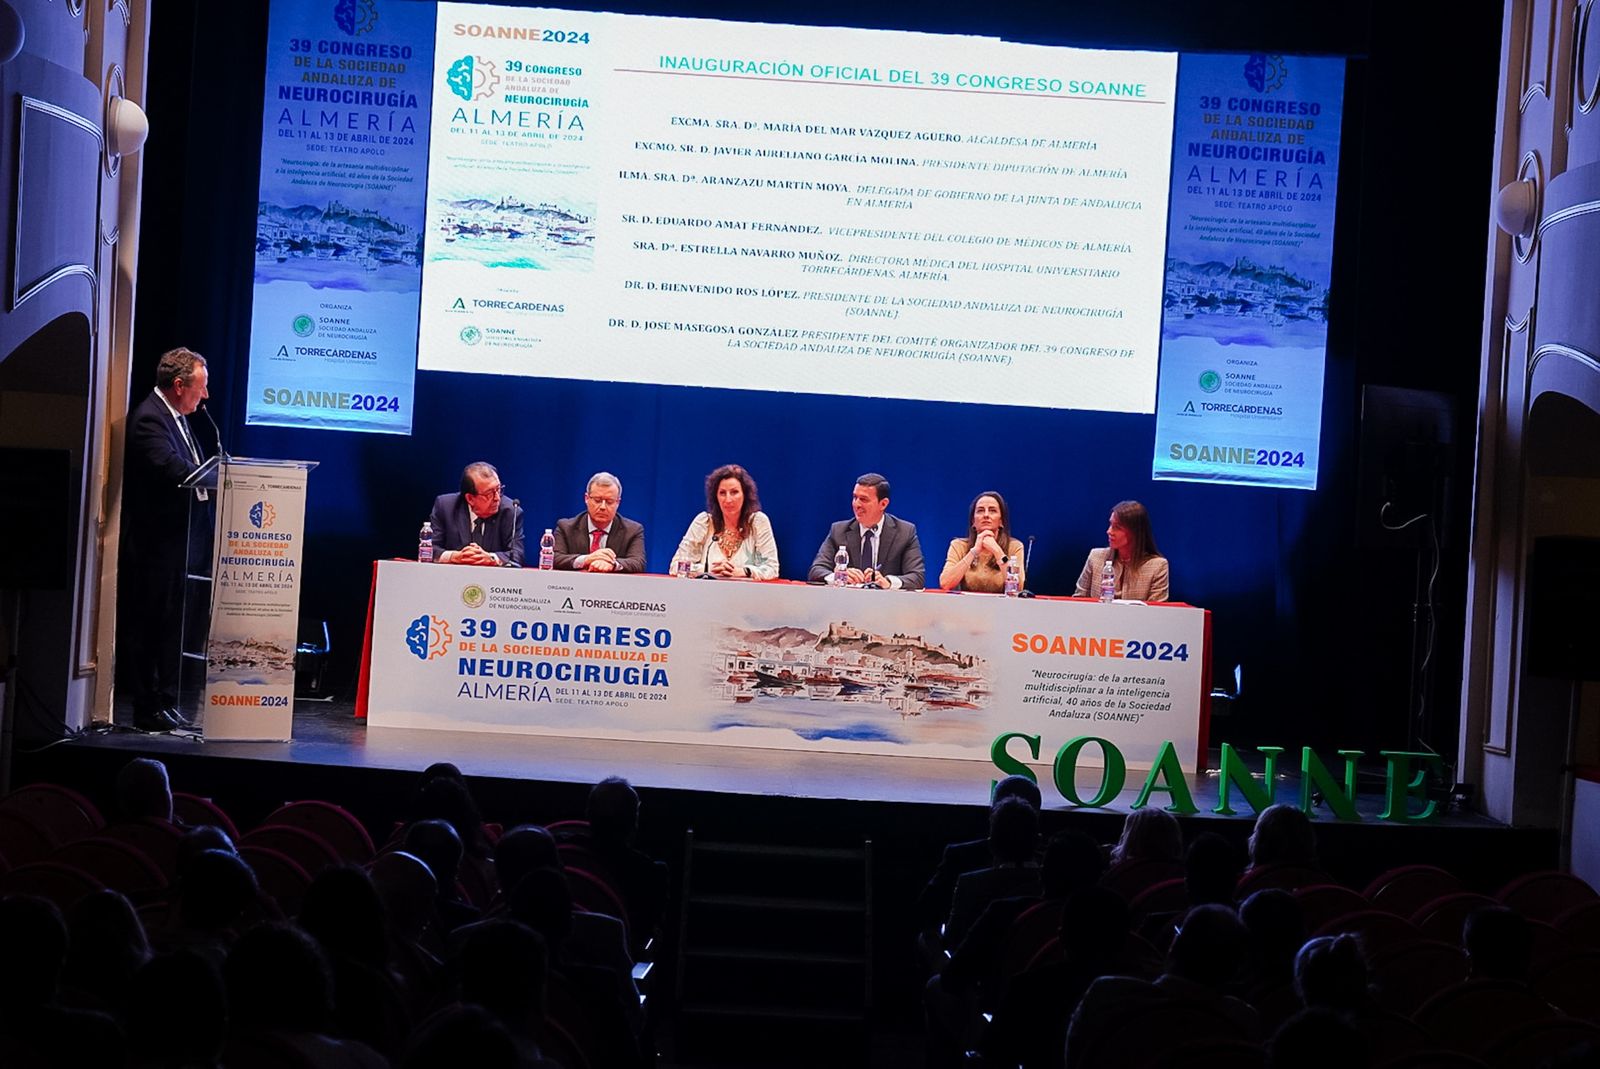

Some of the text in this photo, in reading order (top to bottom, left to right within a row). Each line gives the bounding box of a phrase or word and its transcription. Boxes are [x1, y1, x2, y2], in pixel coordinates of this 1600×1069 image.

[454, 24, 590, 44] SOANNE2024
[290, 38, 412, 59] 39 CONGRESO
[294, 57, 405, 73] DE LA SOCIEDAD
[505, 60, 582, 76] 39 CONGRESO
[302, 72, 396, 88] ANDALUZA DE
[659, 55, 1147, 97] INAUGURACIÓN OFICIAL DEL 39 CONGRESO SOANNE
[279, 86, 417, 108] NEUROCIRUGÍA
[505, 95, 589, 108] NEUROCIRUGÍA
[1200, 96, 1321, 116] 39 CONGRESO
[278, 108, 415, 133] ALMERÍA
[452, 108, 584, 131] ALMERÍA
[1204, 114, 1315, 130] DE LA SOCIEDAD
[279, 129, 294, 138] DEL
[351, 134, 375, 143] ABRIL
[805, 124, 827, 134] DEL
[830, 126, 856, 136] MAR
[860, 128, 912, 140] VAZQUEZ
[1211, 129, 1304, 144] ANDALUZA DE
[714, 146, 751, 156] JAVIER
[755, 148, 822, 161] AURELIANO
[825, 151, 867, 163] GARCÍA
[1188, 143, 1325, 165] NEUROCIRUGÍA
[701, 176, 764, 187] ARANZAZU
[1187, 165, 1323, 189] ALMERÍA
[1188, 186, 1203, 194] DEL
[1259, 191, 1284, 199] ABRIL
[1300, 193, 1321, 201] 2024
[656, 216, 712, 228] EDUARDO
[715, 220, 747, 230] AMAT
[681, 244, 737, 255] ESTRELLA
[741, 247, 795, 258] NAVARRO
[661, 282, 732, 295] BIENVENIDO
[736, 286, 758, 296] ROS
[674, 323, 735, 334] MASEGOSA
[263, 388, 399, 412] SOANNE2024
[1170, 444, 1304, 467] SOANNE2024
[243, 532, 291, 541] CONGRESO
[221, 557, 294, 567] NEUROCIRUGÍA
[221, 570, 293, 582] ALMERÍA
[460, 618, 672, 649] 39 CONGRESO
[459, 642, 668, 663] DE LA SOCIEDAD ANDALUZA DE
[1012, 633, 1188, 661] SOANNE2024
[458, 658, 669, 687] NEUROCIRUGÍA
[1098, 674, 1109, 682] de
[1112, 674, 1120, 683] la
[1123, 676, 1165, 686] artesanía
[457, 682, 552, 703] ALMERÍA
[615, 691, 635, 699] ABRIL
[649, 693, 667, 701] 2024
[1025, 683, 1096, 694] multidisciplinar
[1117, 688, 1170, 698] inteligencia
[211, 695, 288, 706] SOANNE2024
[1023, 695, 1171, 711] artificial, 40 años de la Sociedad
[1049, 710, 1090, 719] Andaluza
[990, 730, 1442, 824] SOANNE
